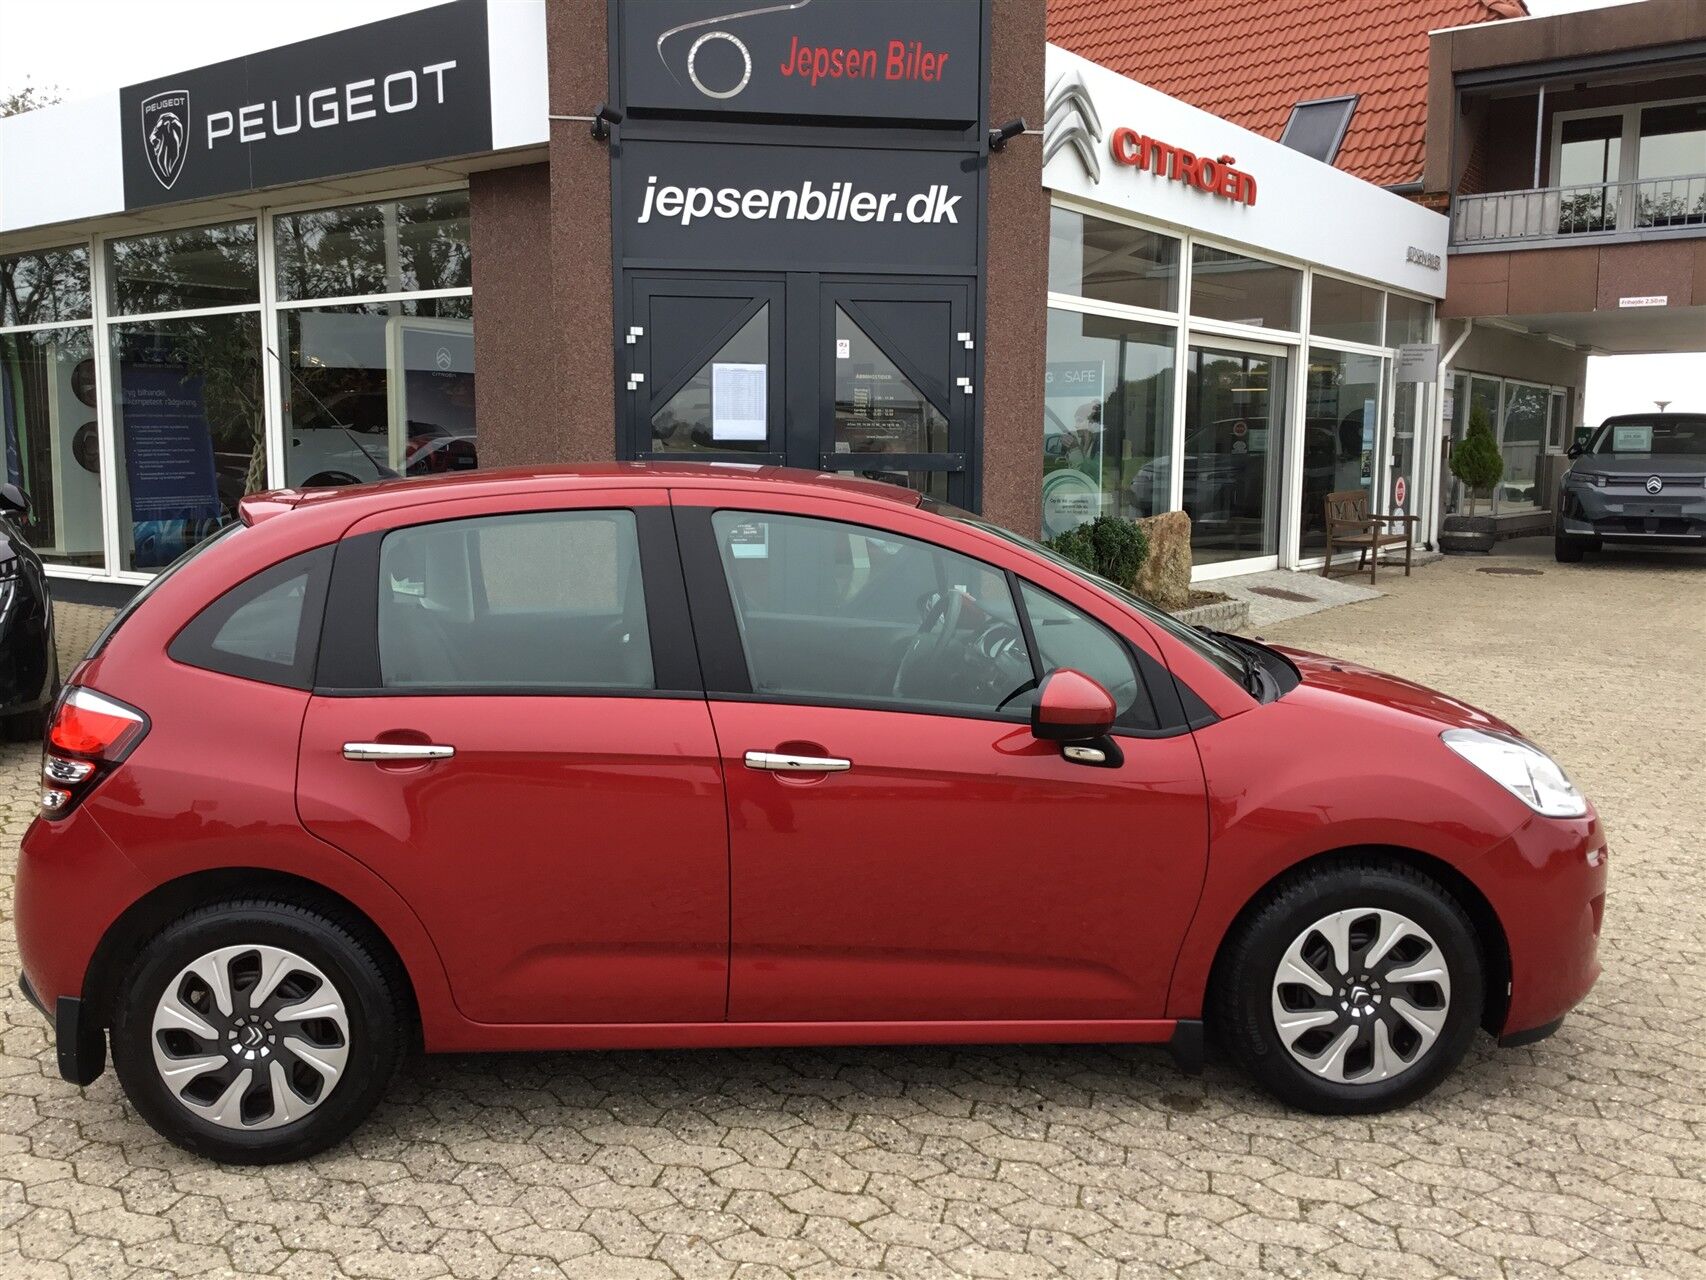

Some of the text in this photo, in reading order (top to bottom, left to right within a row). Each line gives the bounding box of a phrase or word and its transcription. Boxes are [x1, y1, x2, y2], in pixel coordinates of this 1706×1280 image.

[780, 35, 949, 87] Jepsen Biler
[145, 97, 186, 114] PEUGEOT
[207, 60, 457, 150] PEUGEOT
[638, 175, 962, 226] jepsenbiler.dk
[1064, 369, 1097, 383] SAFE
